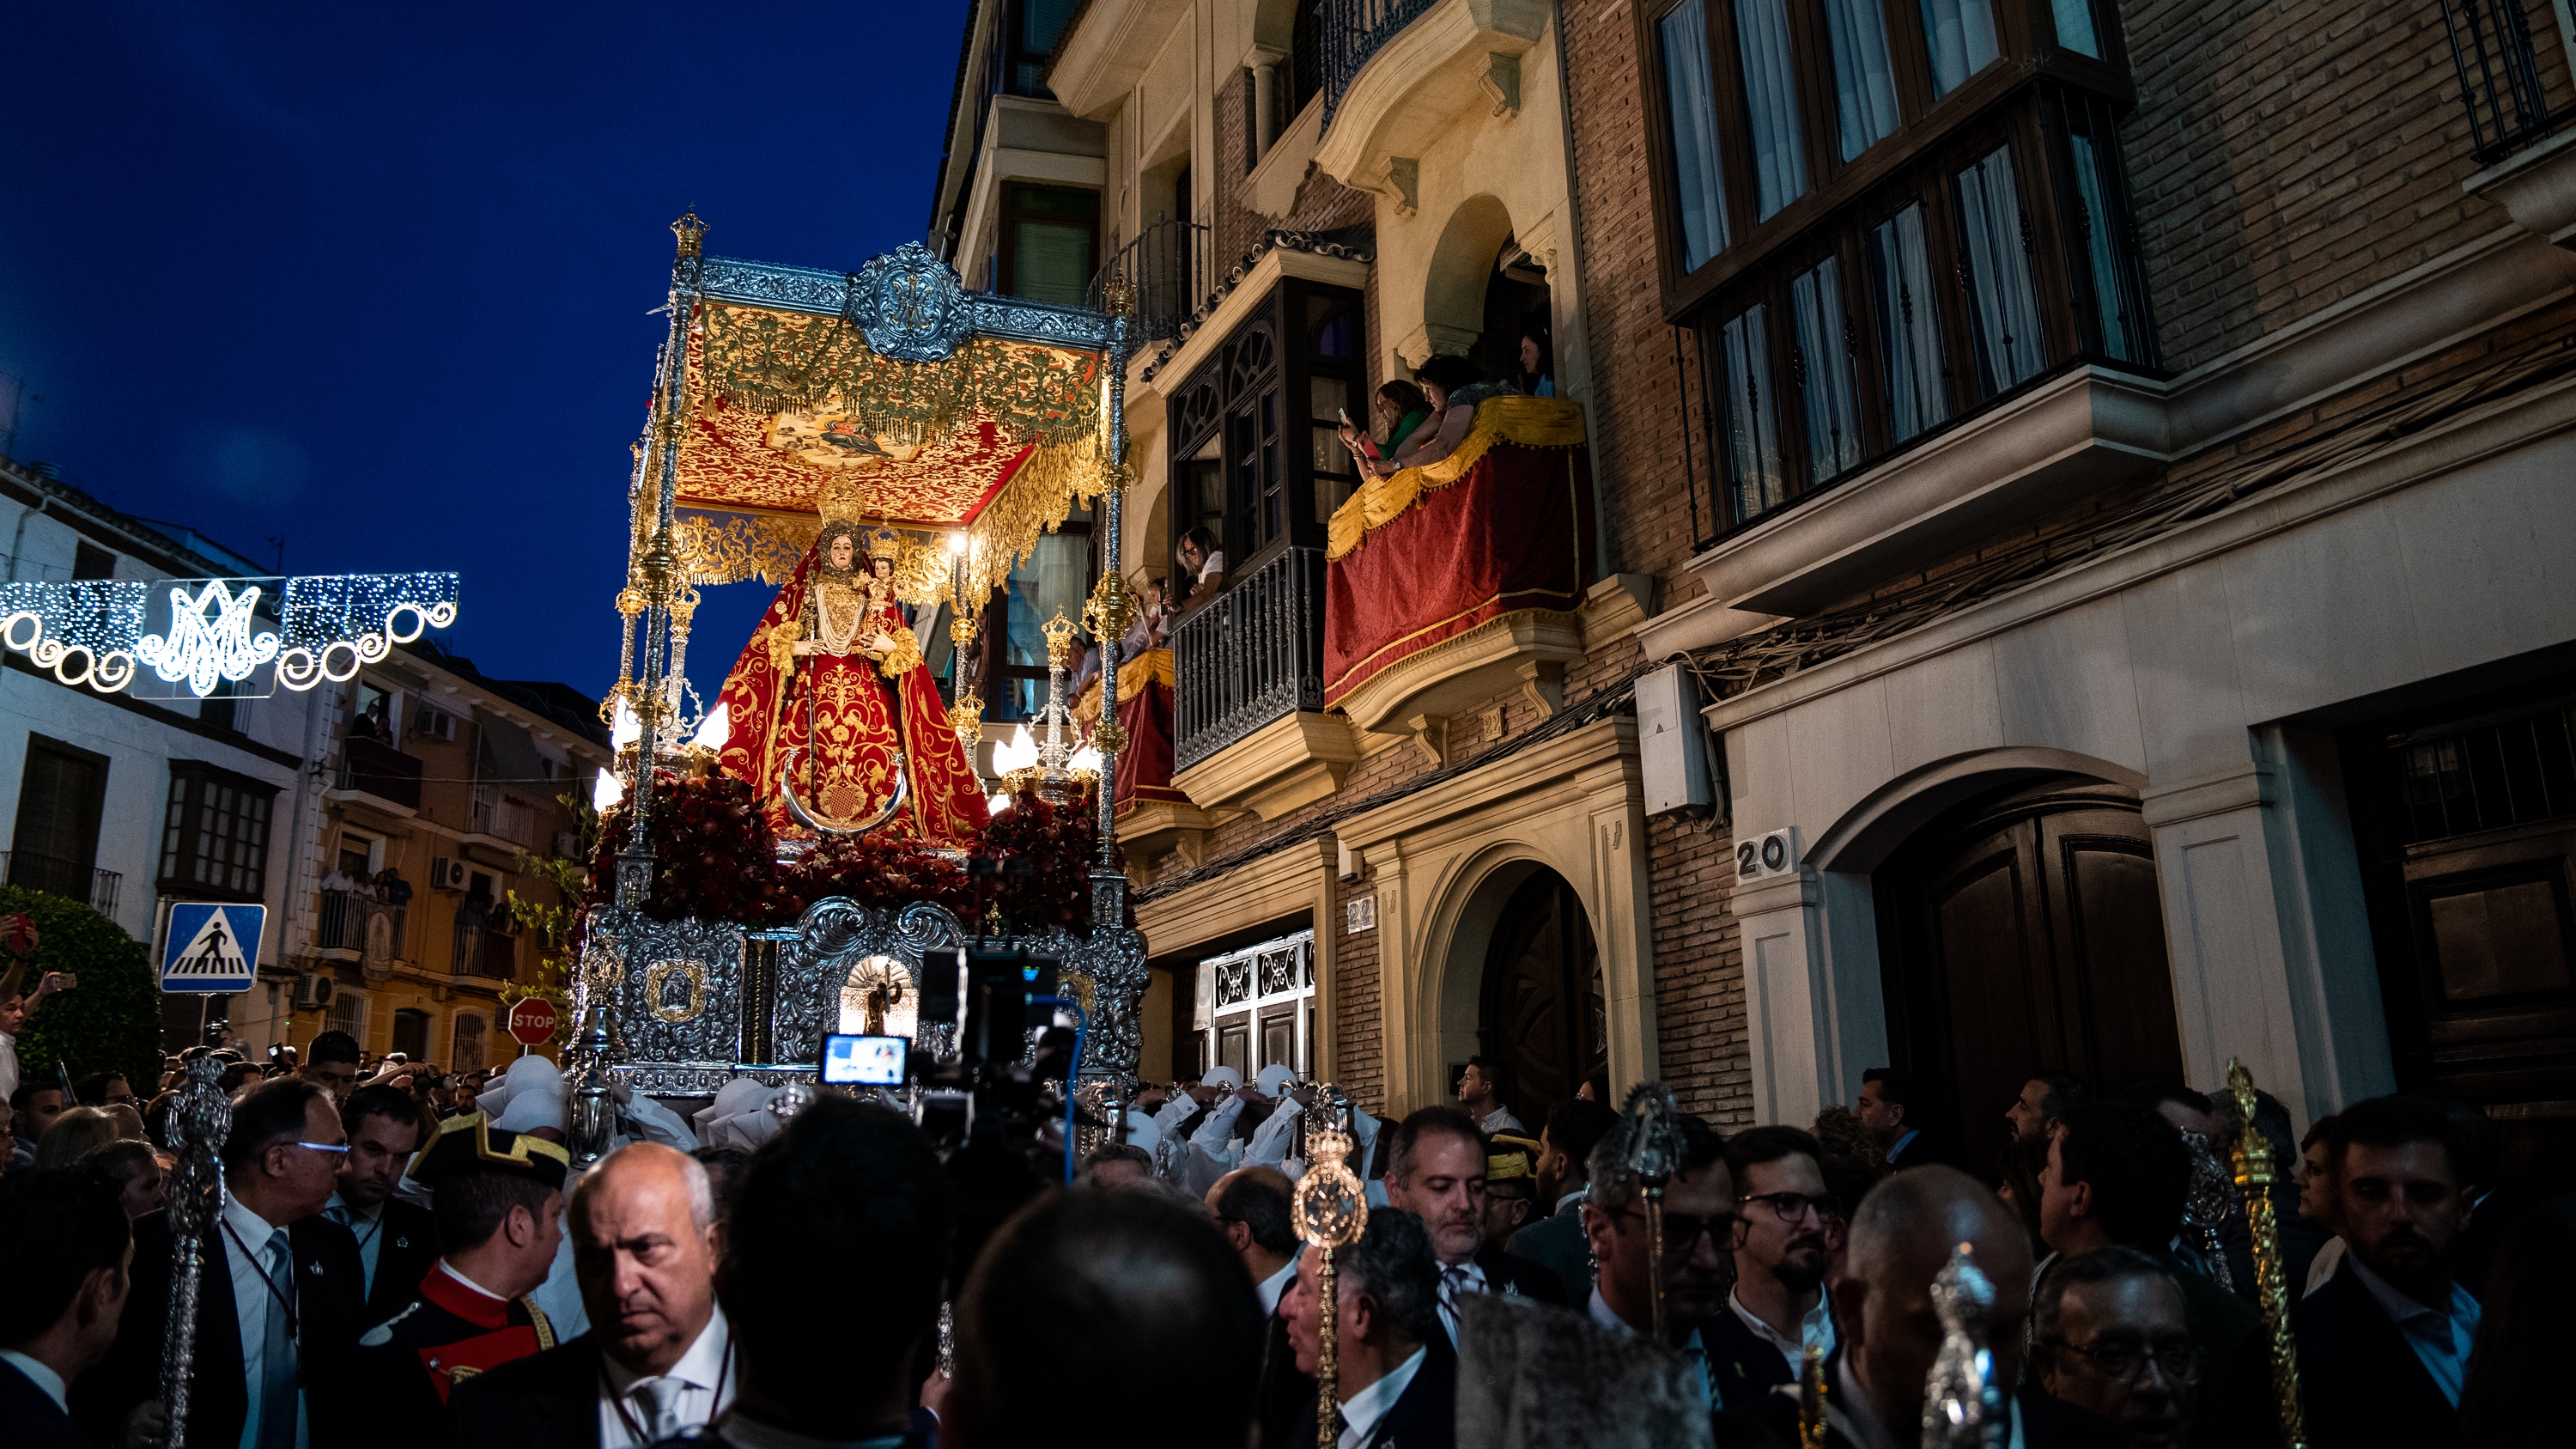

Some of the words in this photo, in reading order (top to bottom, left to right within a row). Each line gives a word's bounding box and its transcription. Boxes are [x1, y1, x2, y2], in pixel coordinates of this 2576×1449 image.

[1737, 834, 1786, 878] 20
[1348, 898, 1372, 927] 22
[513, 1014, 556, 1029] STOP
